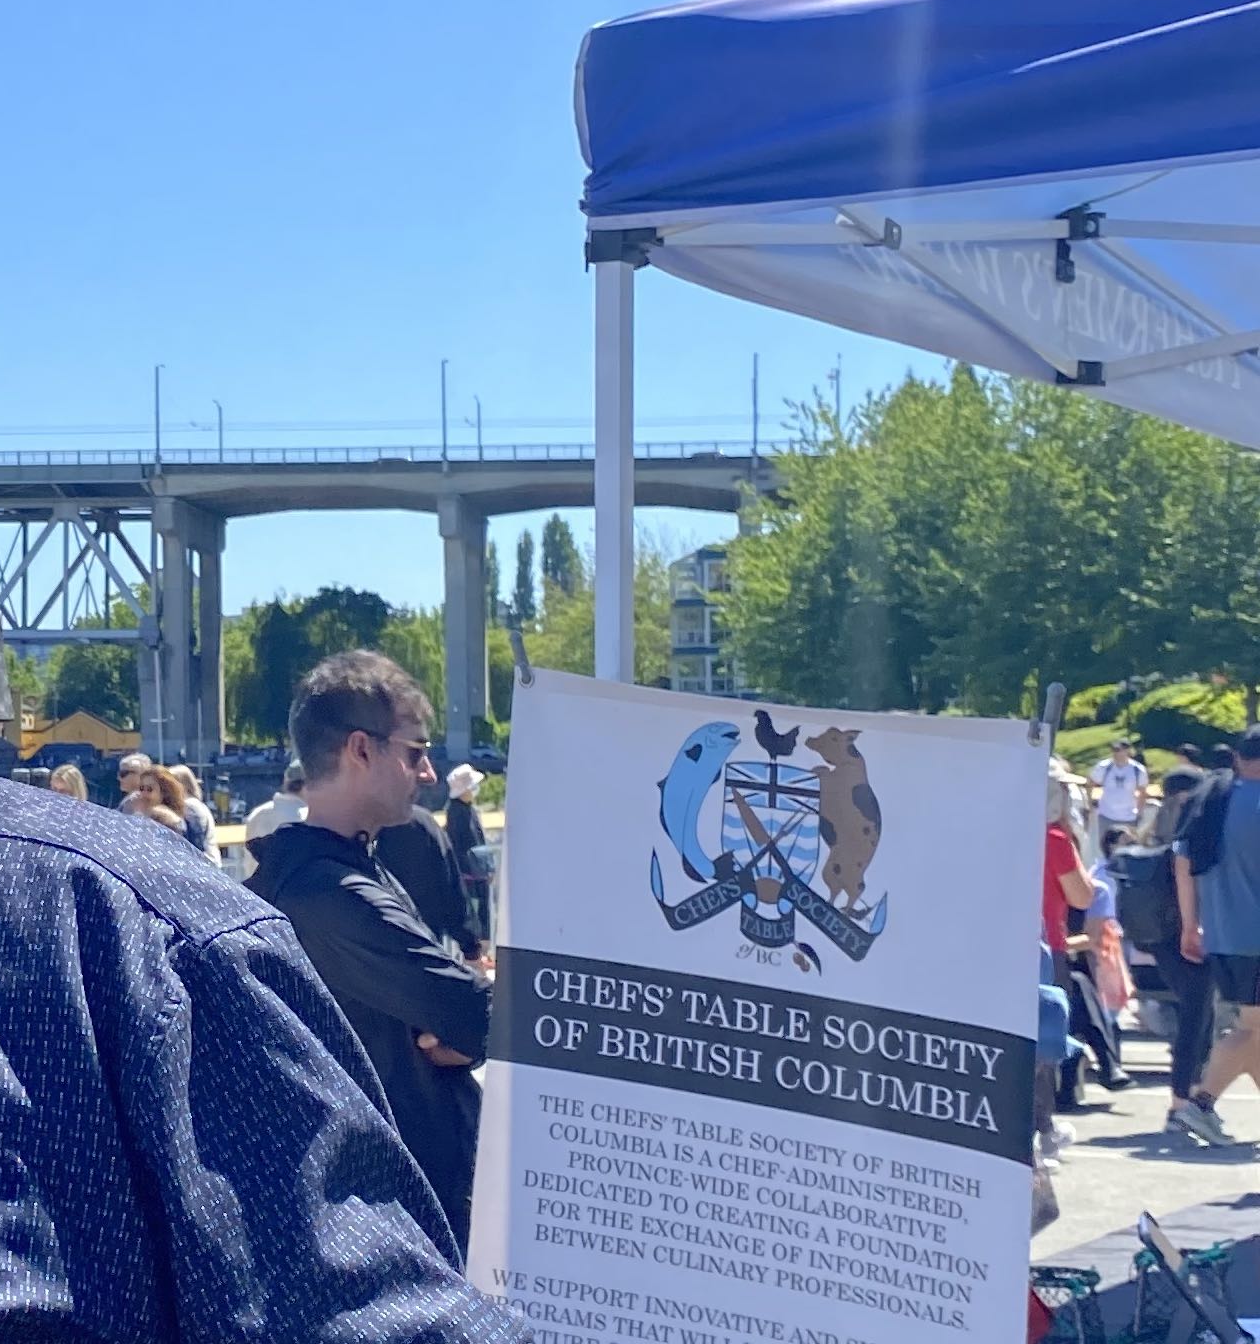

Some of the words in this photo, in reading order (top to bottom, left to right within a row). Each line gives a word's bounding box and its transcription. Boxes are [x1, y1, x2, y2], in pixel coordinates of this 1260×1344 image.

[741, 914, 793, 939] TABLE
[756, 953, 782, 966] BC
[788, 883, 868, 952] SOCIETY
[534, 967, 673, 1017] CHEFS'
[683, 991, 810, 1043] TABLE
[823, 1017, 1003, 1081] SOCIETY
[534, 1015, 588, 1052] OF
[598, 1023, 760, 1084] BRITISH
[775, 1055, 998, 1132] COLUMBIA
[540, 1095, 584, 1118] THE
[591, 1104, 668, 1131] CHEFS'
[672, 1117, 743, 1146] TABLE
[749, 1133, 846, 1166] SOCIETY
[853, 1153, 883, 1174] OF
[890, 1160, 981, 1198] BRITISH
[549, 1122, 667, 1159] COLUMBIA
[674, 1144, 693, 1163] IS
[699, 1150, 712, 1167] A
[719, 1153, 968, 1225] CHEF-ADMINISTERED,
[524, 1170, 652, 1207] DEDICATED
[659, 1193, 688, 1214] TO
[695, 1201, 810, 1239] CREATING
[816, 1227, 829, 1244] A
[836, 1229, 988, 1281] FOUNDATION
[567, 1151, 750, 1201] PROVINCE-WIDE
[757, 1187, 947, 1244] COLLABORATIVE
[535, 1224, 646, 1259] BETWEEN
[653, 1246, 769, 1284] CULINARY
[536, 1198, 580, 1221] FOR
[588, 1207, 633, 1230] THE
[640, 1216, 766, 1256] EXCHANGE
[772, 1243, 803, 1262] OF
[810, 1250, 972, 1304] INFORMATION
[493, 1268, 527, 1291] WE
[534, 1276, 639, 1310] SUPPORT
[644, 1296, 784, 1341] INNOVATIVE
[612, 1316, 675, 1343] THAT
